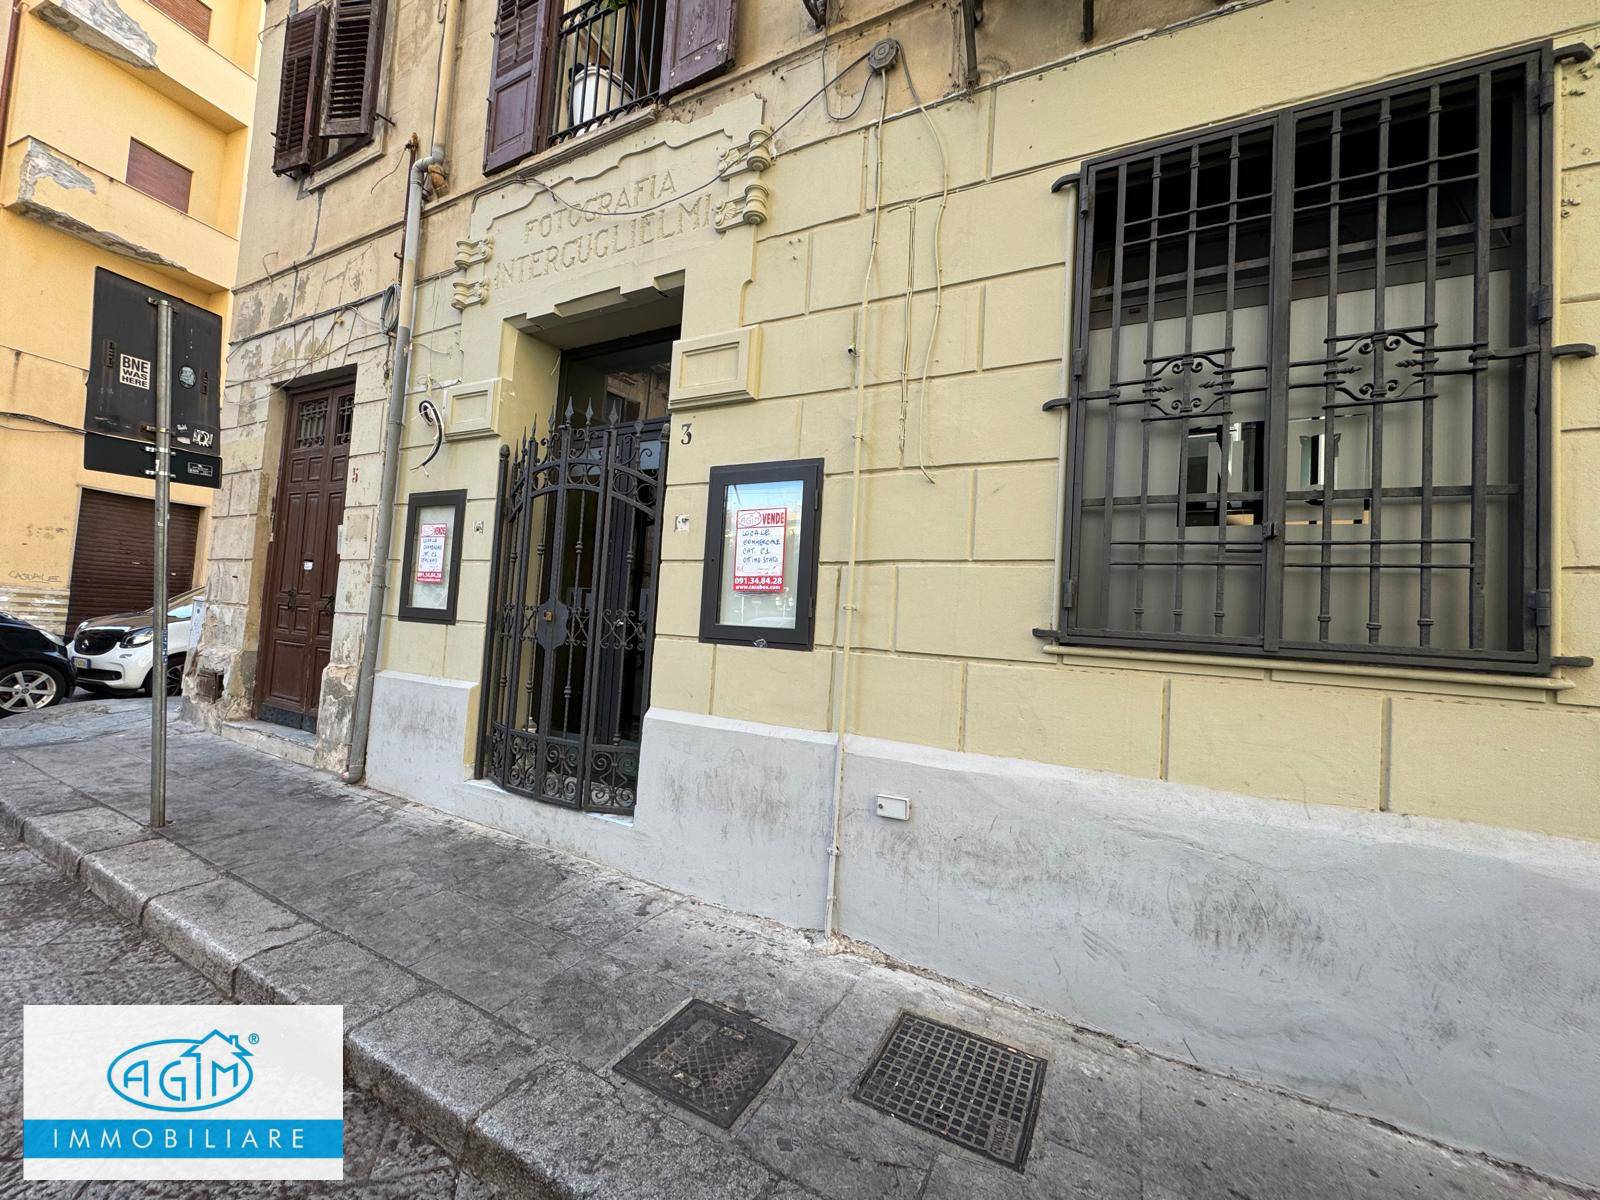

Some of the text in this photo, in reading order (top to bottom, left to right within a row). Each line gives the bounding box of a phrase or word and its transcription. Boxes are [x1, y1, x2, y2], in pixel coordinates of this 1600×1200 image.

[522, 168, 677, 244] FOTOGRAFIA
[493, 192, 713, 290] INTERGUGLIELMI
[122, 355, 149, 374] BNE
[121, 375, 148, 387] HERE
[122, 368, 148, 380] WAS
[680, 422, 693, 445] 3
[762, 512, 785, 525] VENDE
[734, 577, 782, 585] 091.34.84.28
